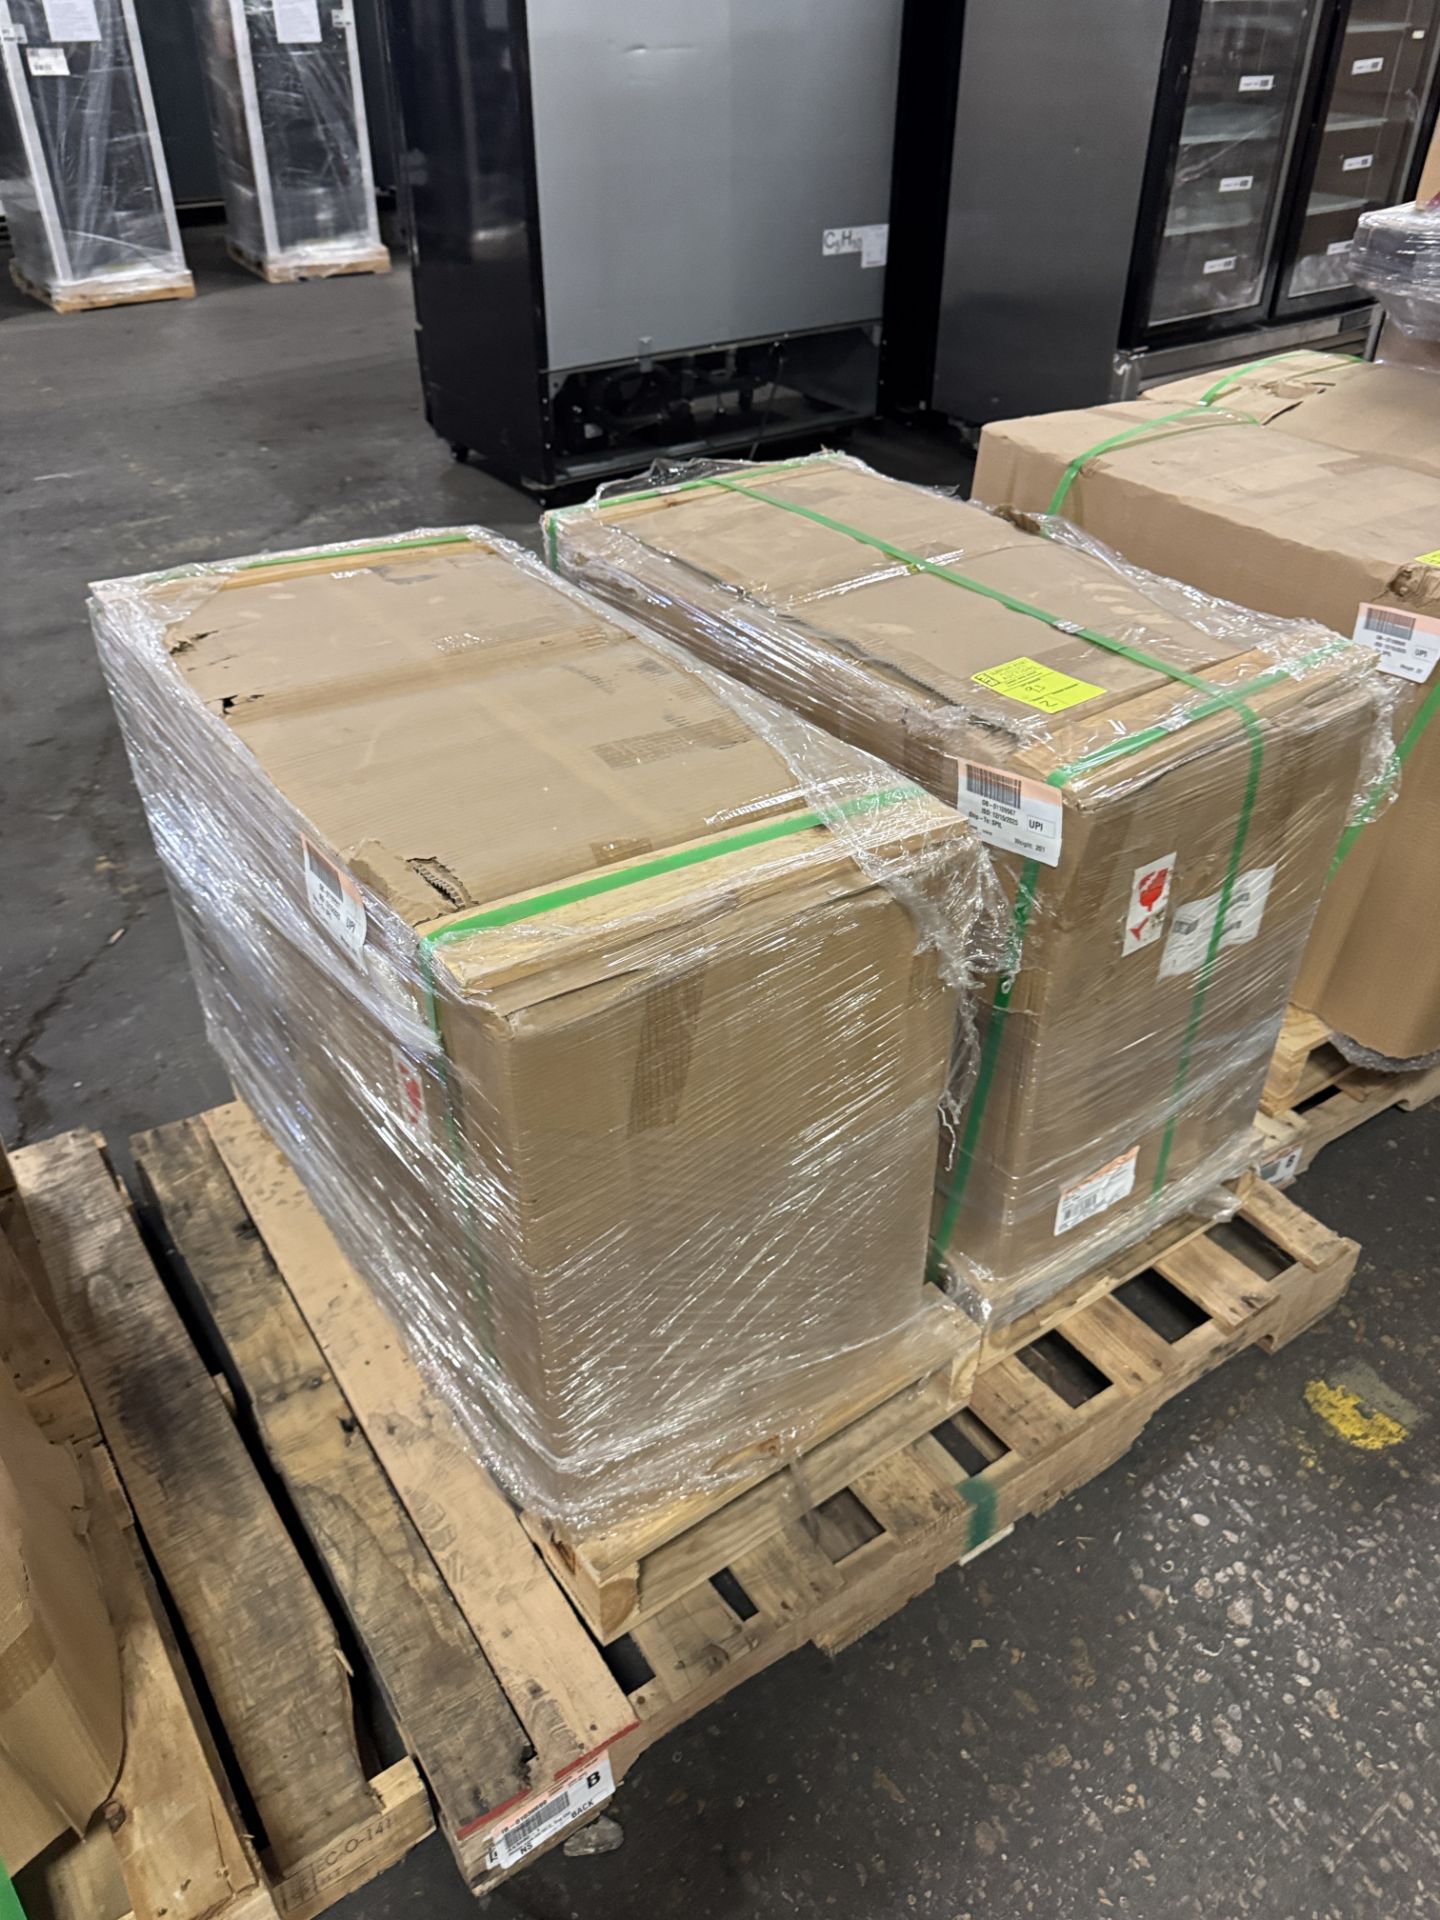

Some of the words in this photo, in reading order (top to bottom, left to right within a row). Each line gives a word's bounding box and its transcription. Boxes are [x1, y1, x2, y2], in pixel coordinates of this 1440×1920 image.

[1028, 819, 1044, 832] UPI
[586, 1771, 601, 1789] B
[571, 1799, 595, 1819] BACK
